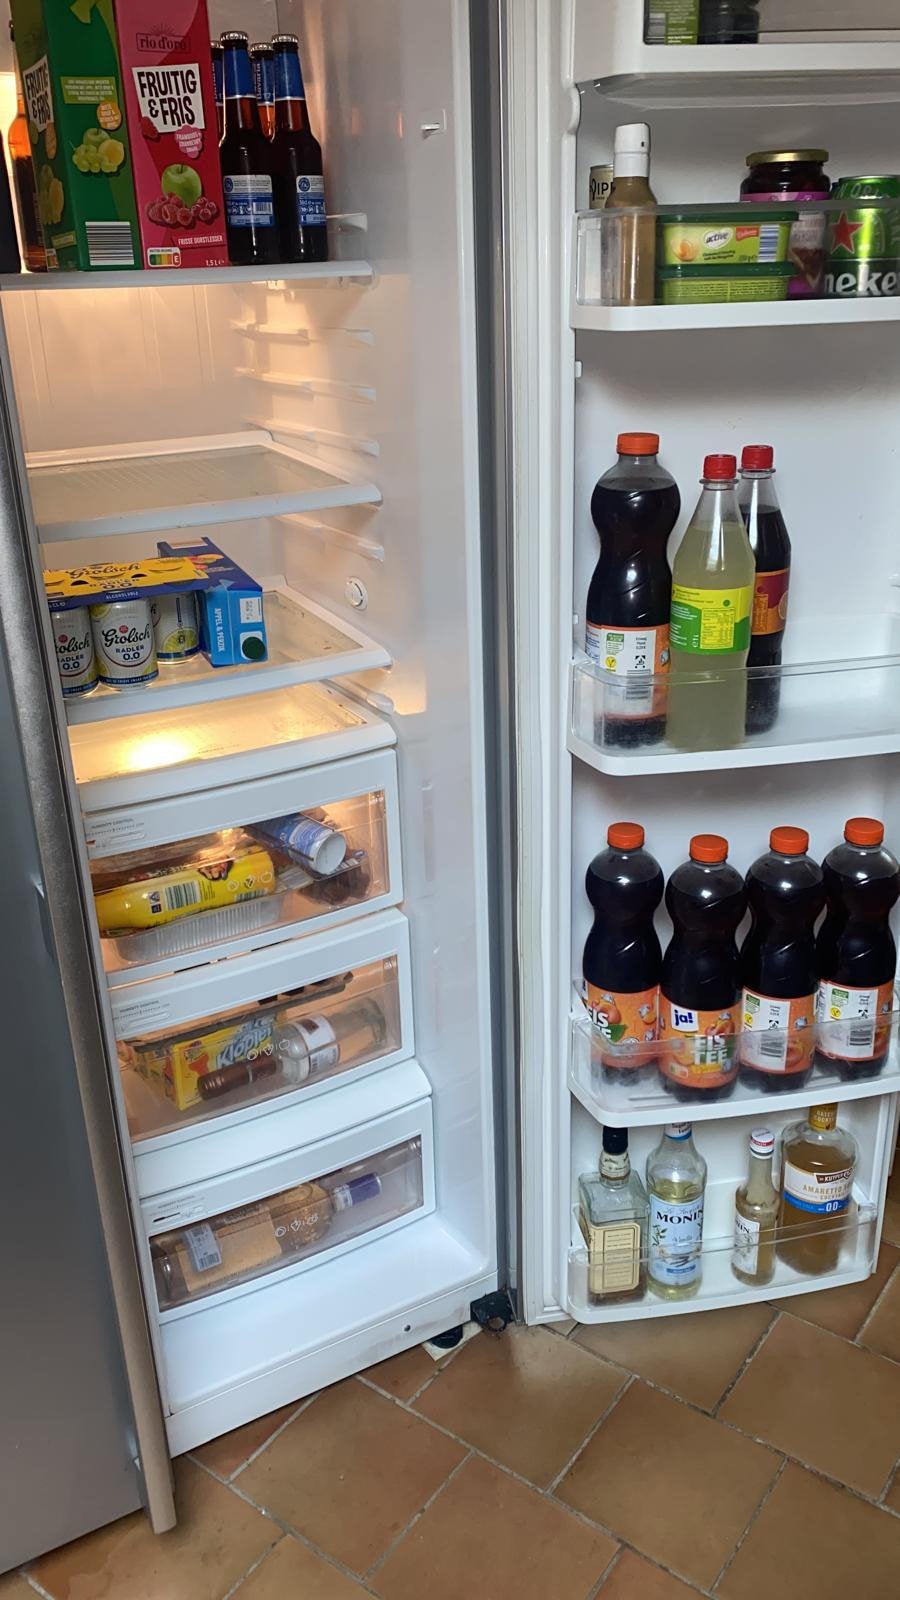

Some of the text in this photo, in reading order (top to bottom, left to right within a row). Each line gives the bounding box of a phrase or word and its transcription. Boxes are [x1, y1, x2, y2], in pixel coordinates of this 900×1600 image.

[140, 36, 186, 50] rio d'oro
[25, 61, 51, 100] FRUITIG
[137, 69, 197, 98] FRUITIG
[148, 98, 159, 119] &
[159, 96, 196, 127] FRIS
[706, 232, 729, 244] active
[174, 255, 180, 264] E
[102, 623, 151, 649] Grolsch
[115, 645, 145, 654] RADLER
[123, 652, 141, 663] 0.0
[674, 1009, 694, 1027] ja!
[694, 1035, 726, 1051] EIS
[690, 1049, 728, 1066] TEE
[656, 1208, 704, 1225] MONIN
